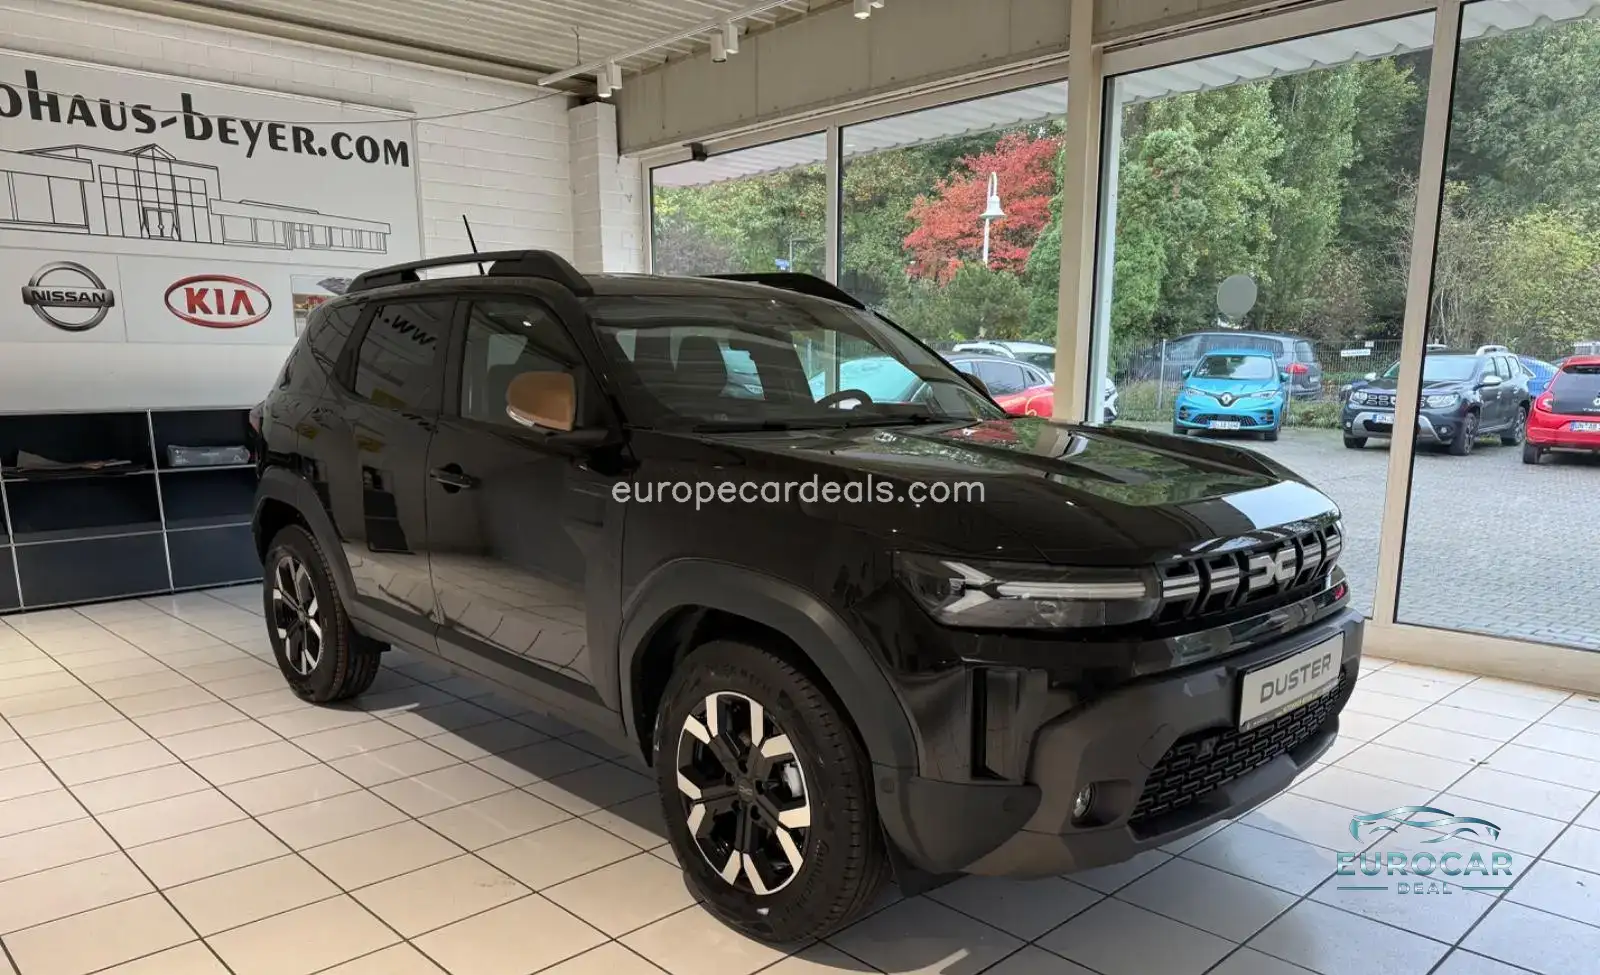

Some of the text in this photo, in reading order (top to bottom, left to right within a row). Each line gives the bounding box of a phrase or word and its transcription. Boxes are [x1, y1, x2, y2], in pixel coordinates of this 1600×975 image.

[31, 289, 107, 303] NISSAN
[184, 287, 256, 316] KIA
[1260, 653, 1332, 703] DUSTER
